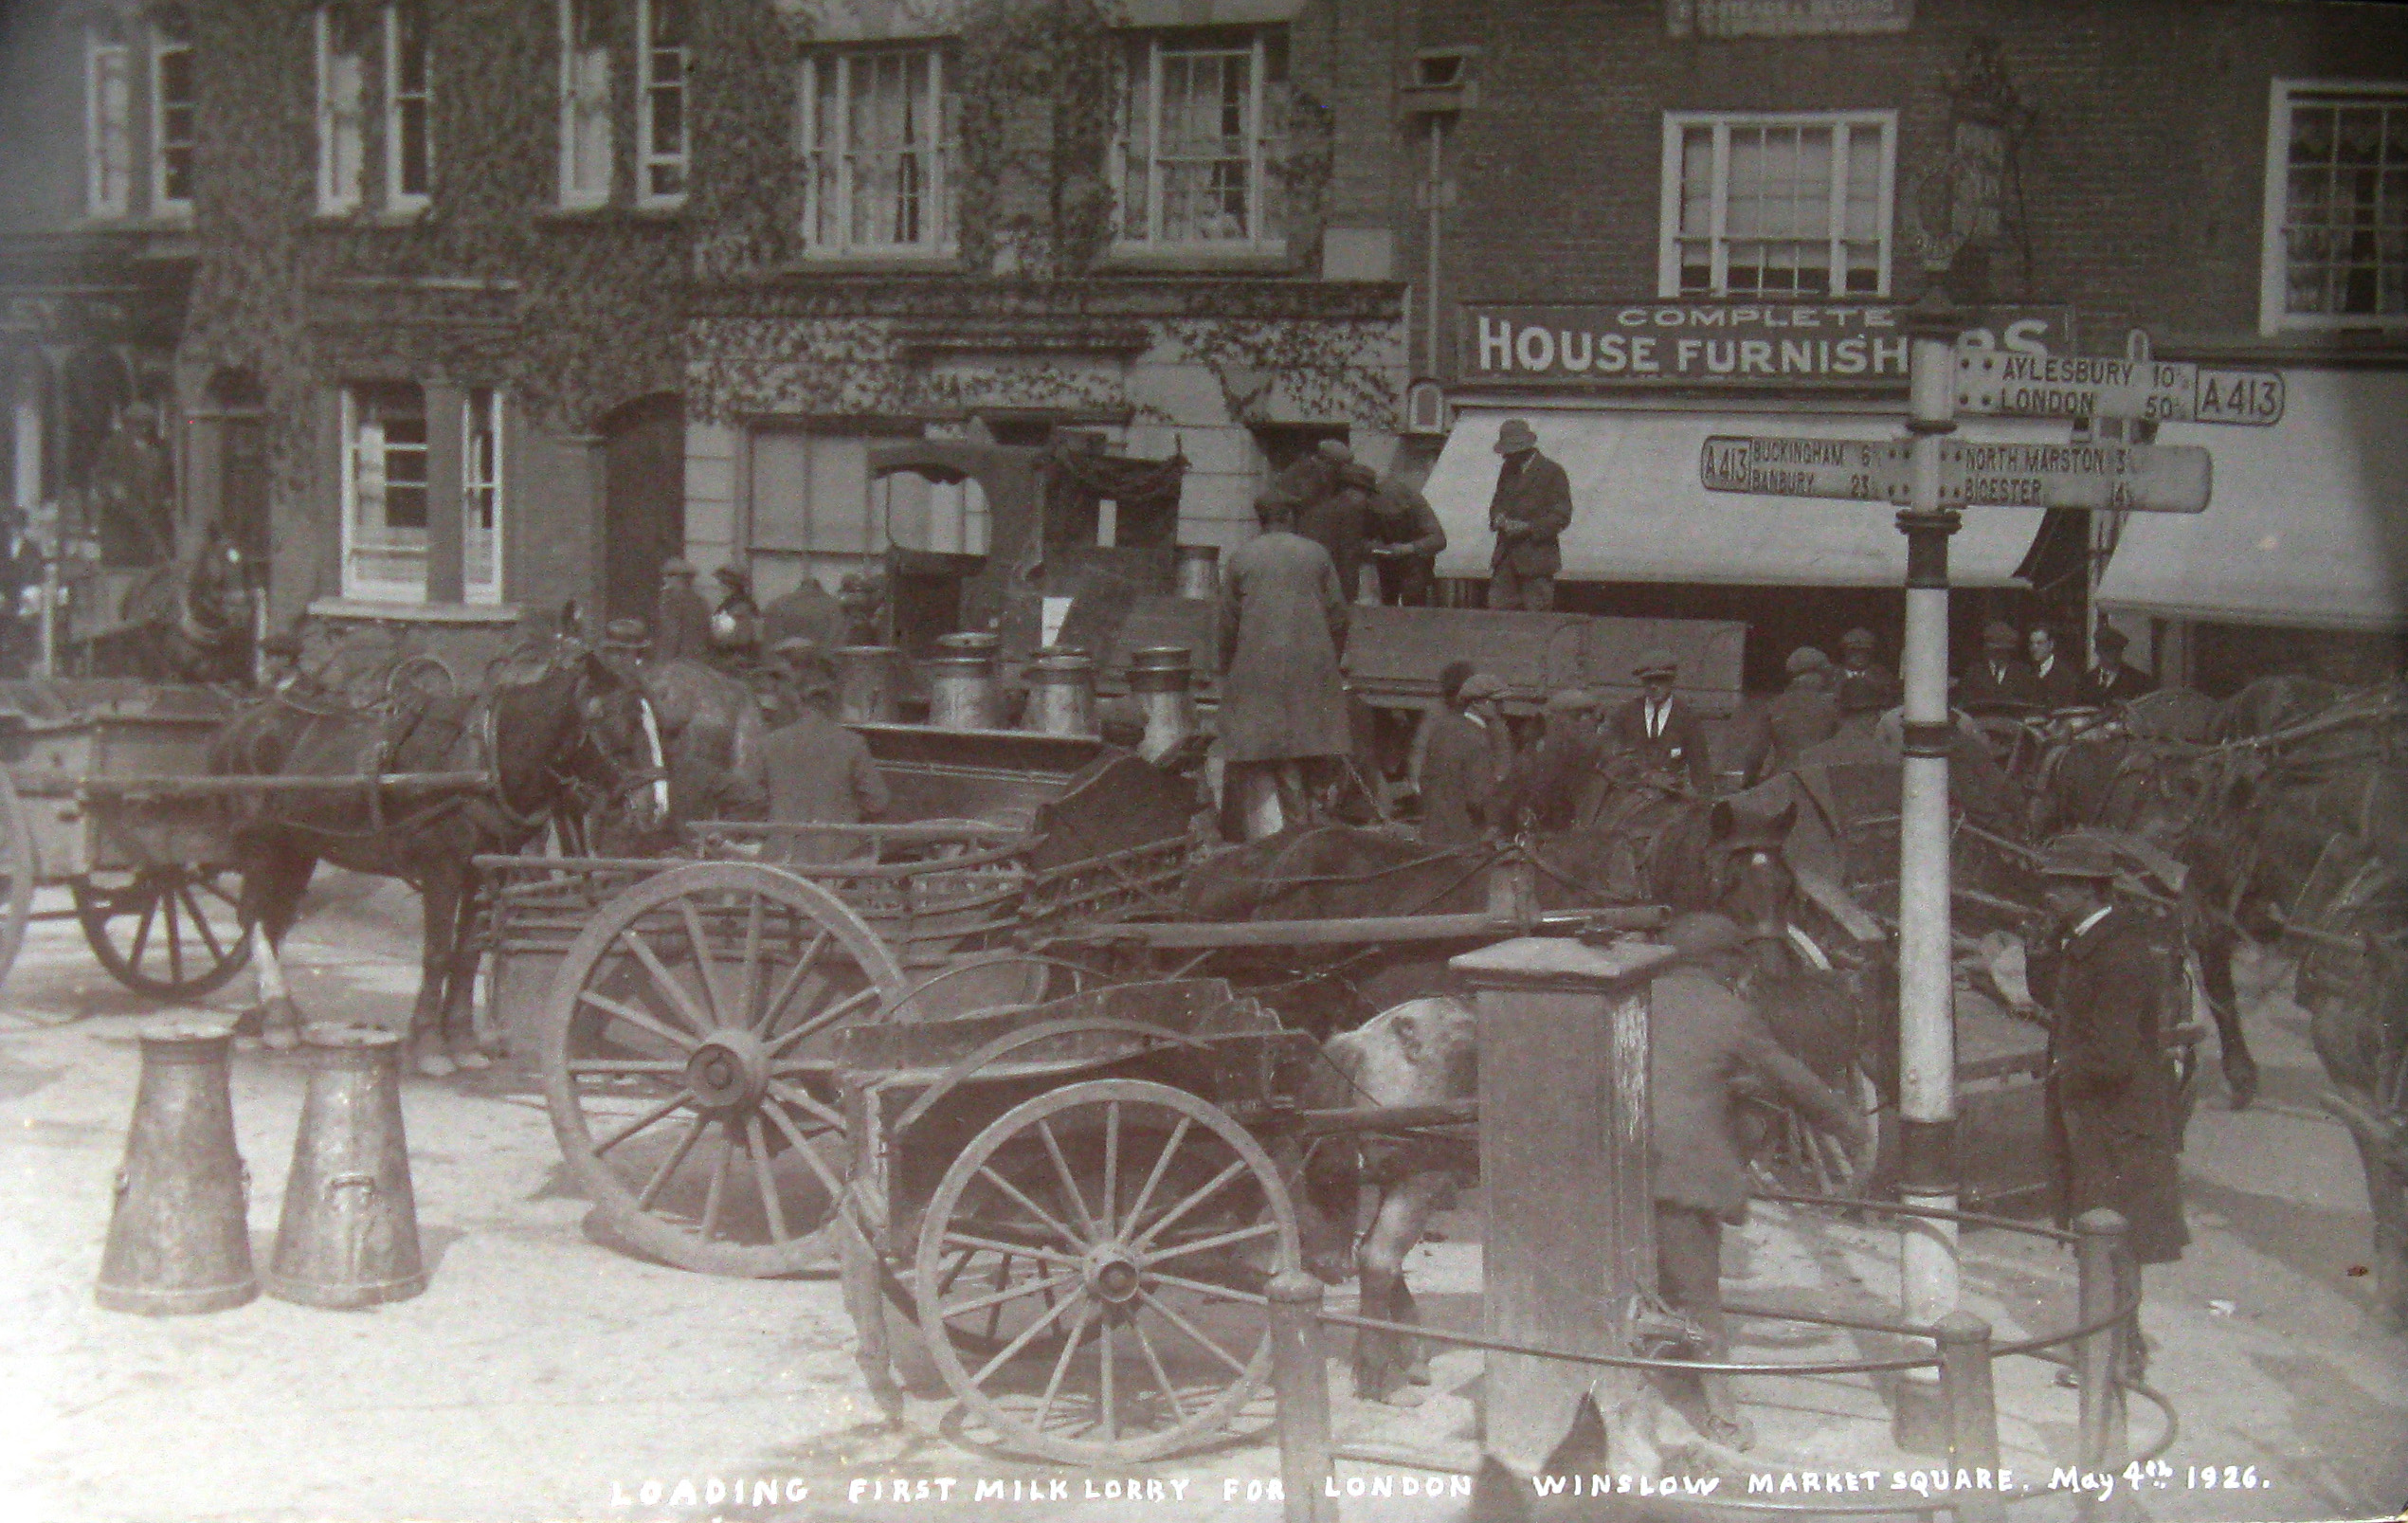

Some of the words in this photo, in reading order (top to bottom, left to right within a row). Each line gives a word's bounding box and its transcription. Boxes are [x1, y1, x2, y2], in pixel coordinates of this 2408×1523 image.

[1617, 305, 1895, 328] COMPLETE
[1477, 317, 1660, 372] HOUSE
[2001, 355, 2134, 387] AYLESBURY
[2001, 388, 2094, 415] LONDON
[1751, 439, 1845, 467] BUCKINGHAM
[1964, 446, 2019, 473] NORTH
[2024, 446, 2105, 475] MARSTON
[1751, 468, 1816, 495] BANBURY
[1964, 476, 2043, 506] BICESTER
